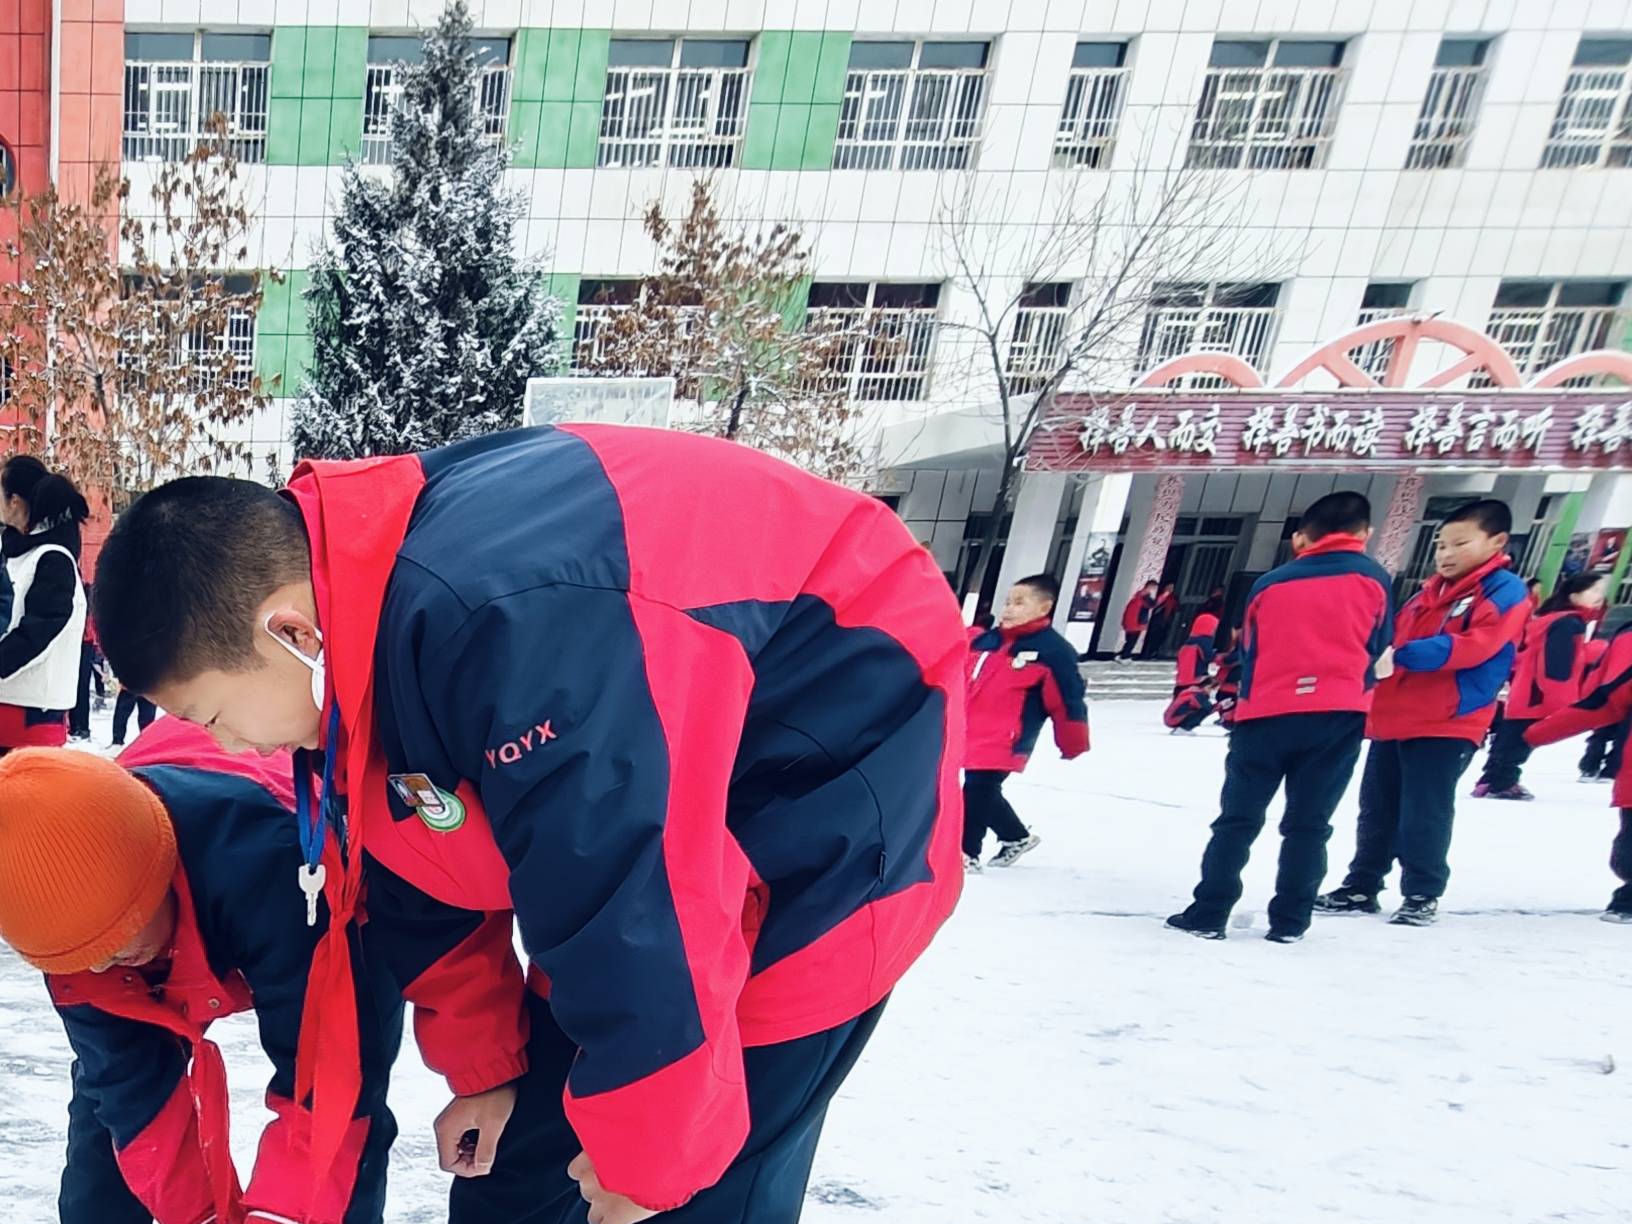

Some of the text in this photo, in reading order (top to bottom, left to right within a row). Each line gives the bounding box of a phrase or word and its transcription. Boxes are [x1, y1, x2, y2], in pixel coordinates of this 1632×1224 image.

[1242, 403, 1385, 458] 择善书而读
[1404, 402, 1554, 457] 择善言而听
[485, 719, 557, 769] YQYX
